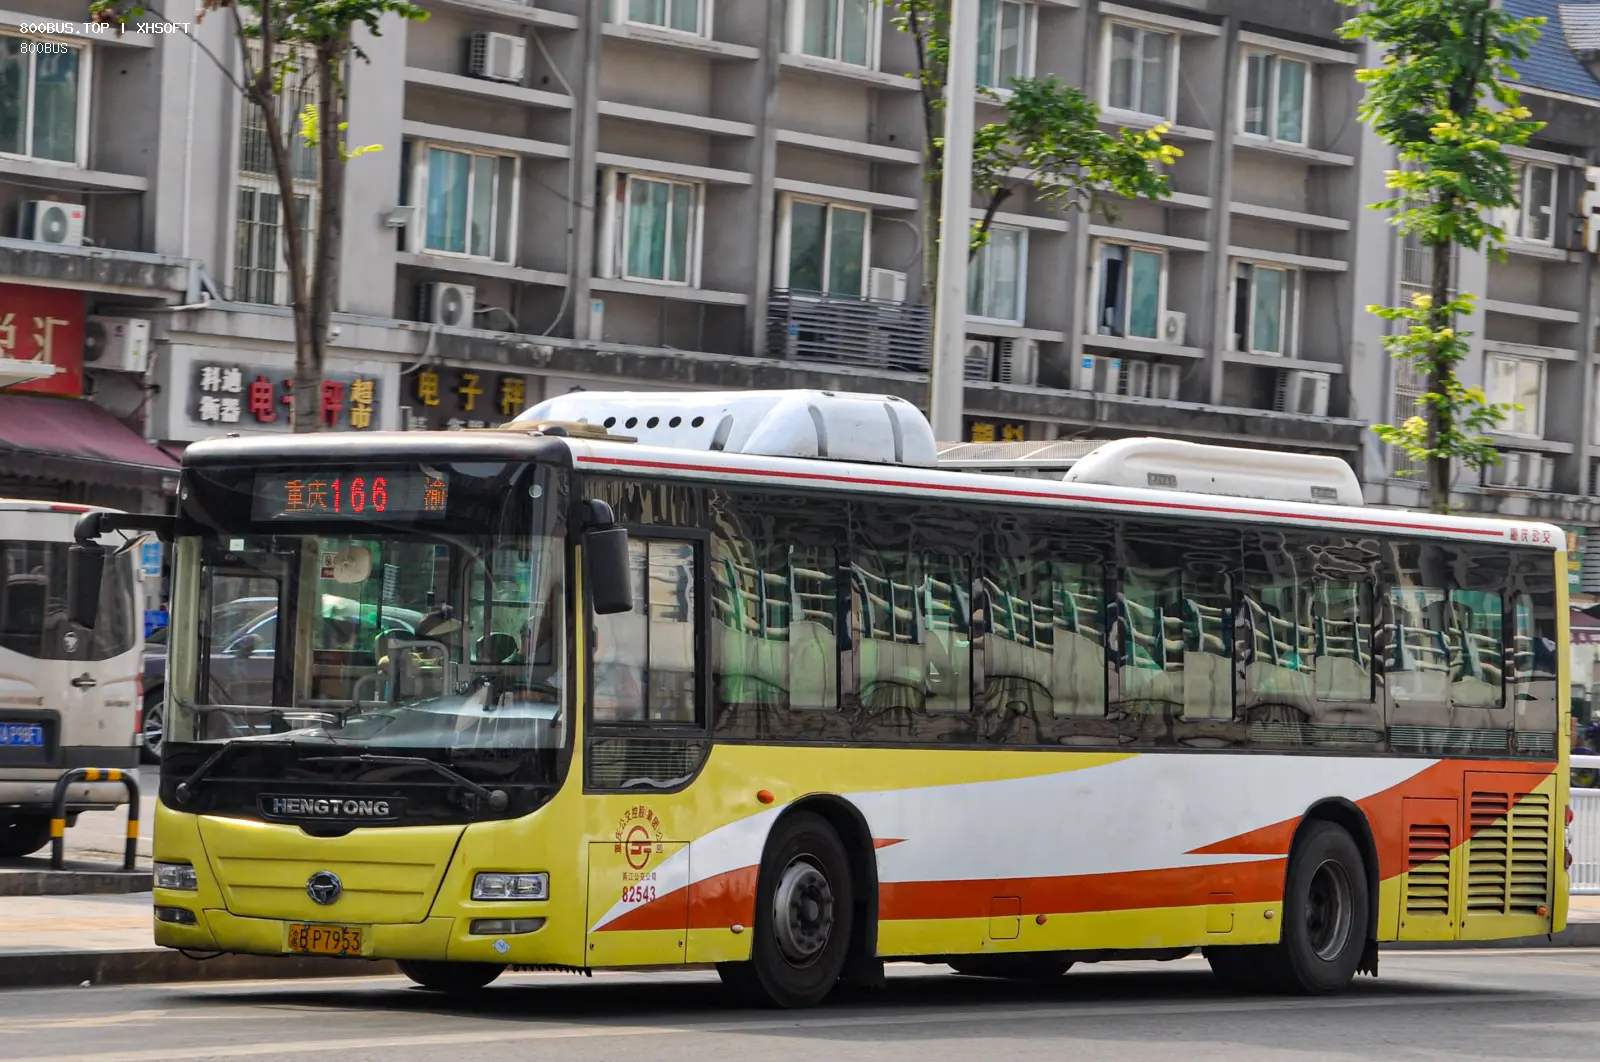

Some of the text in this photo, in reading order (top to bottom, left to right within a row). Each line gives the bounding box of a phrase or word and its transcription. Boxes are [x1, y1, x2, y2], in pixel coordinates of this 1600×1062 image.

[350, 379, 376, 428] 超市
[1510, 527, 1551, 544] 重庆公交
[273, 798, 389, 815] HENGTONG
[622, 886, 656, 903] 82543
